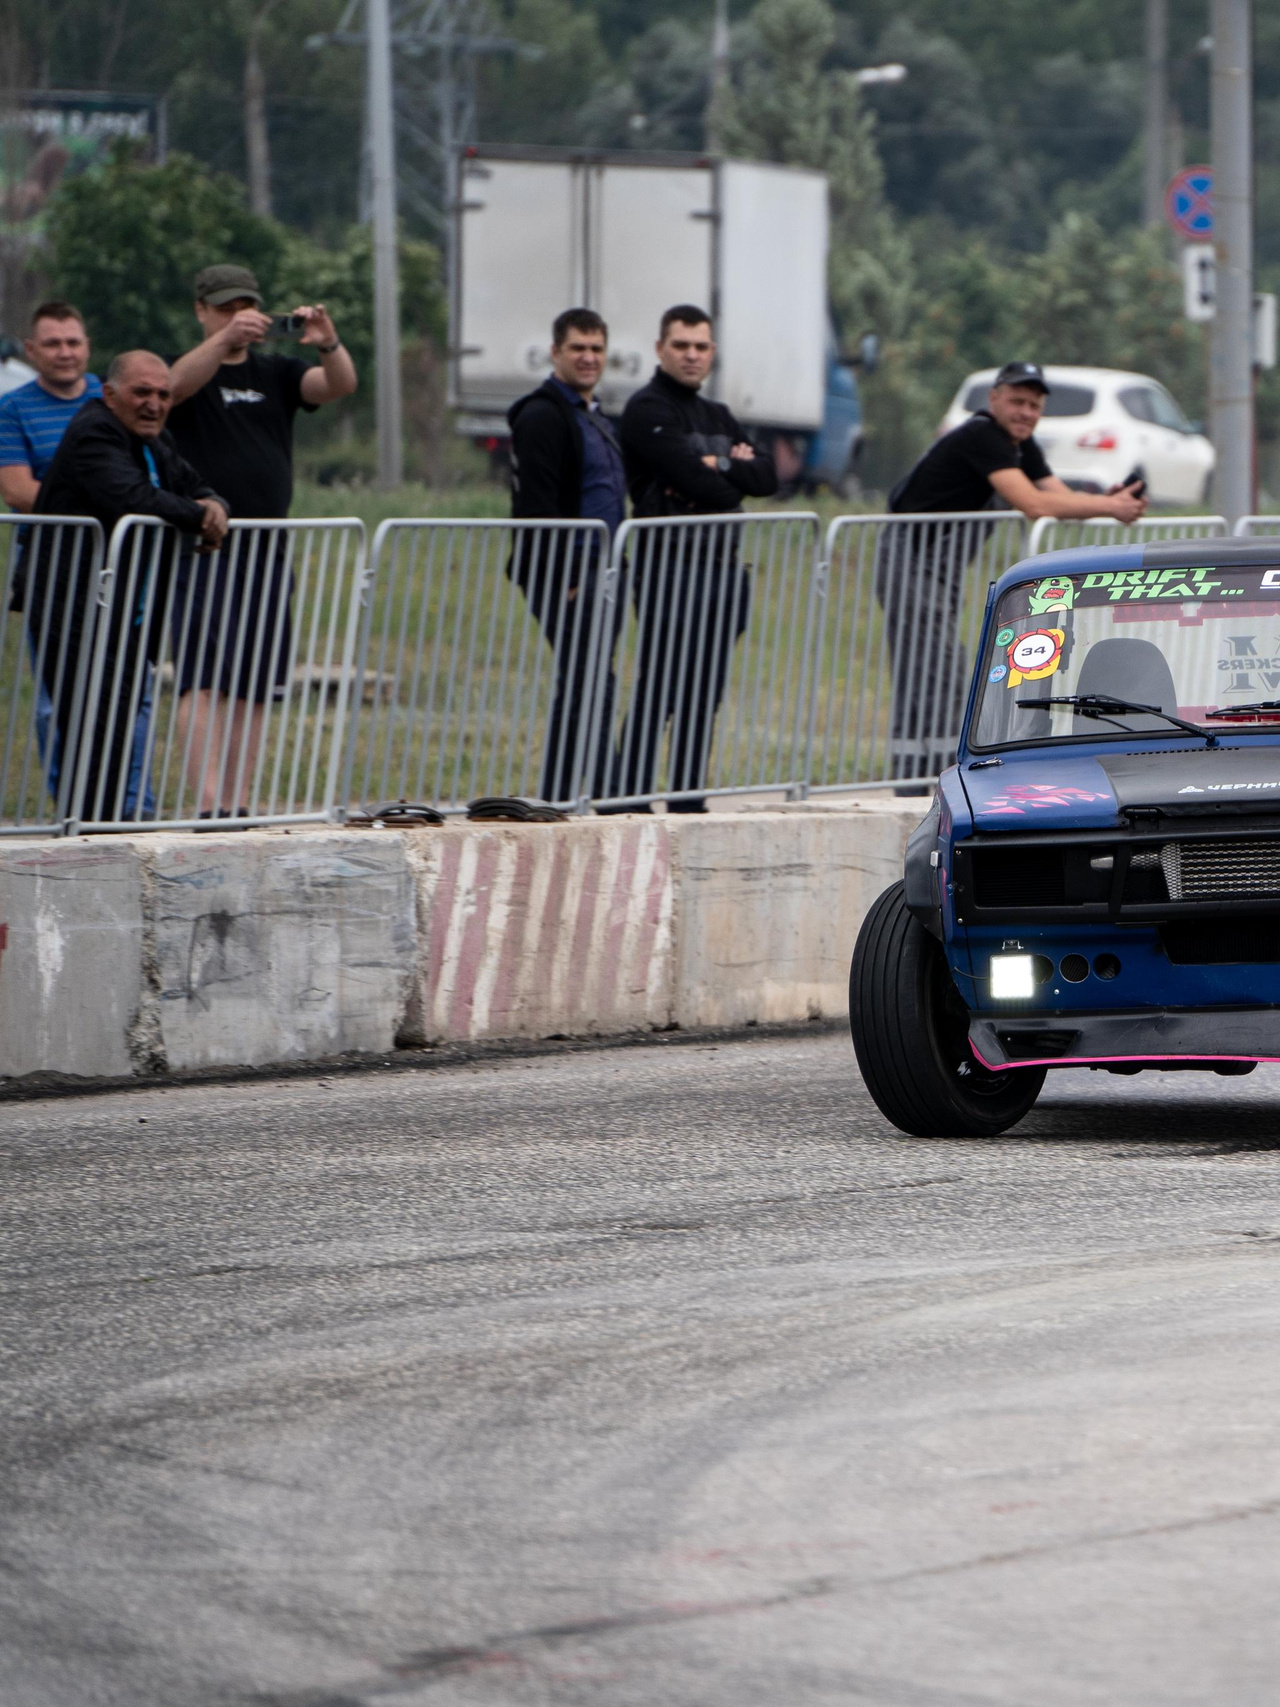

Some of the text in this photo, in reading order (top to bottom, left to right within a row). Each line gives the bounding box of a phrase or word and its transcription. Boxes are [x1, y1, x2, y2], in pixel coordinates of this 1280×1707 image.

[1081, 567, 1217, 589] DRIFT
[1106, 581, 1245, 600] THAT...
[1021, 645, 1047, 657] 34
